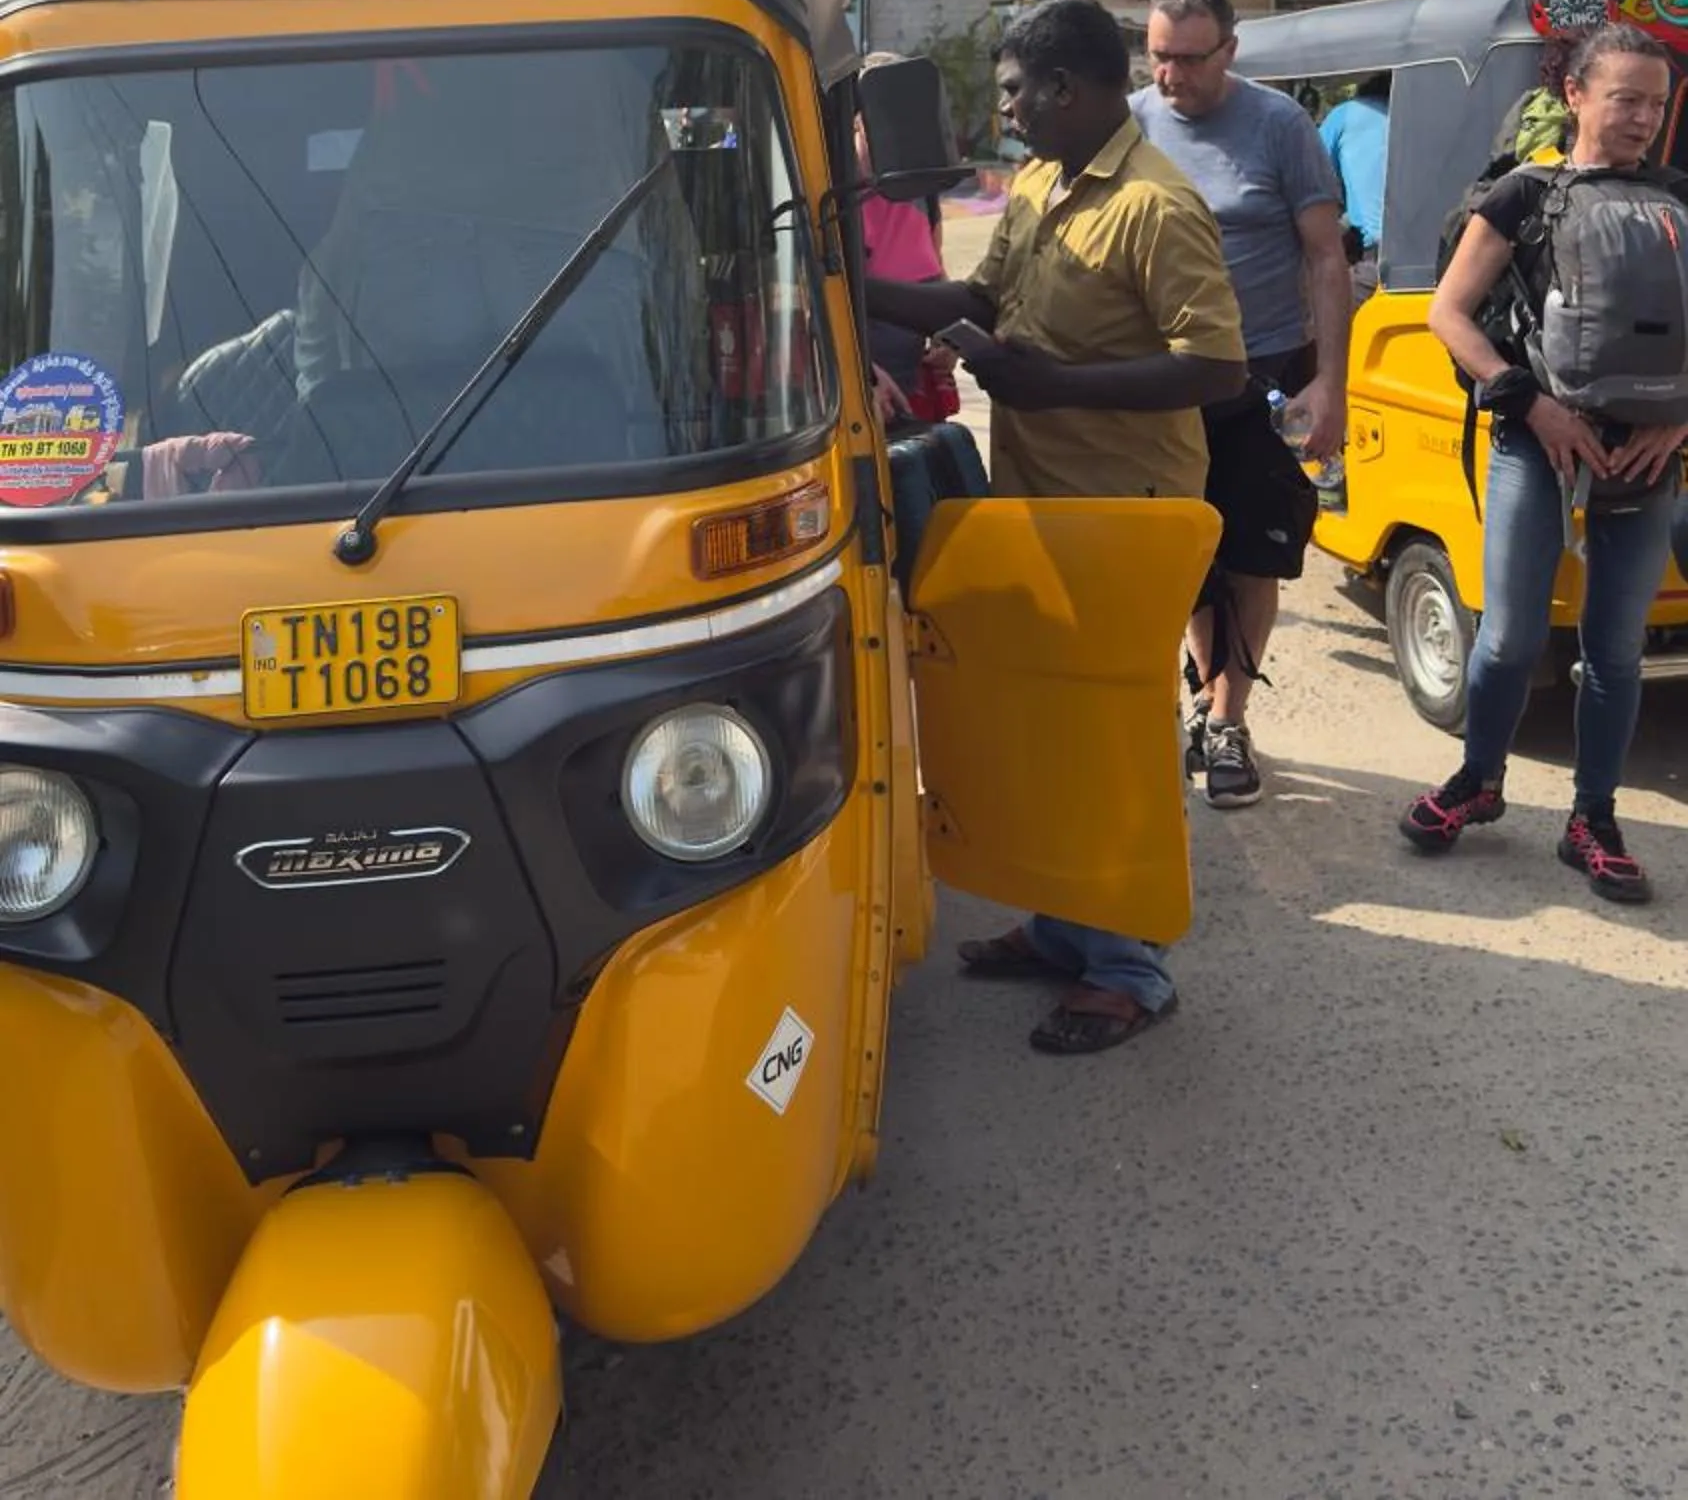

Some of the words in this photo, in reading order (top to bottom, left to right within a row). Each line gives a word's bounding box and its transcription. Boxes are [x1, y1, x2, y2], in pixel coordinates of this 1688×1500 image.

[2, 443, 17, 457] TN
[20, 442, 33, 456] 19
[36, 441, 54, 455] BT
[281, 605, 432, 661] TN19B
[281, 653, 431, 710] T1068
[325, 829, 377, 843] BAJAJ
[763, 1036, 803, 1084] CNG
